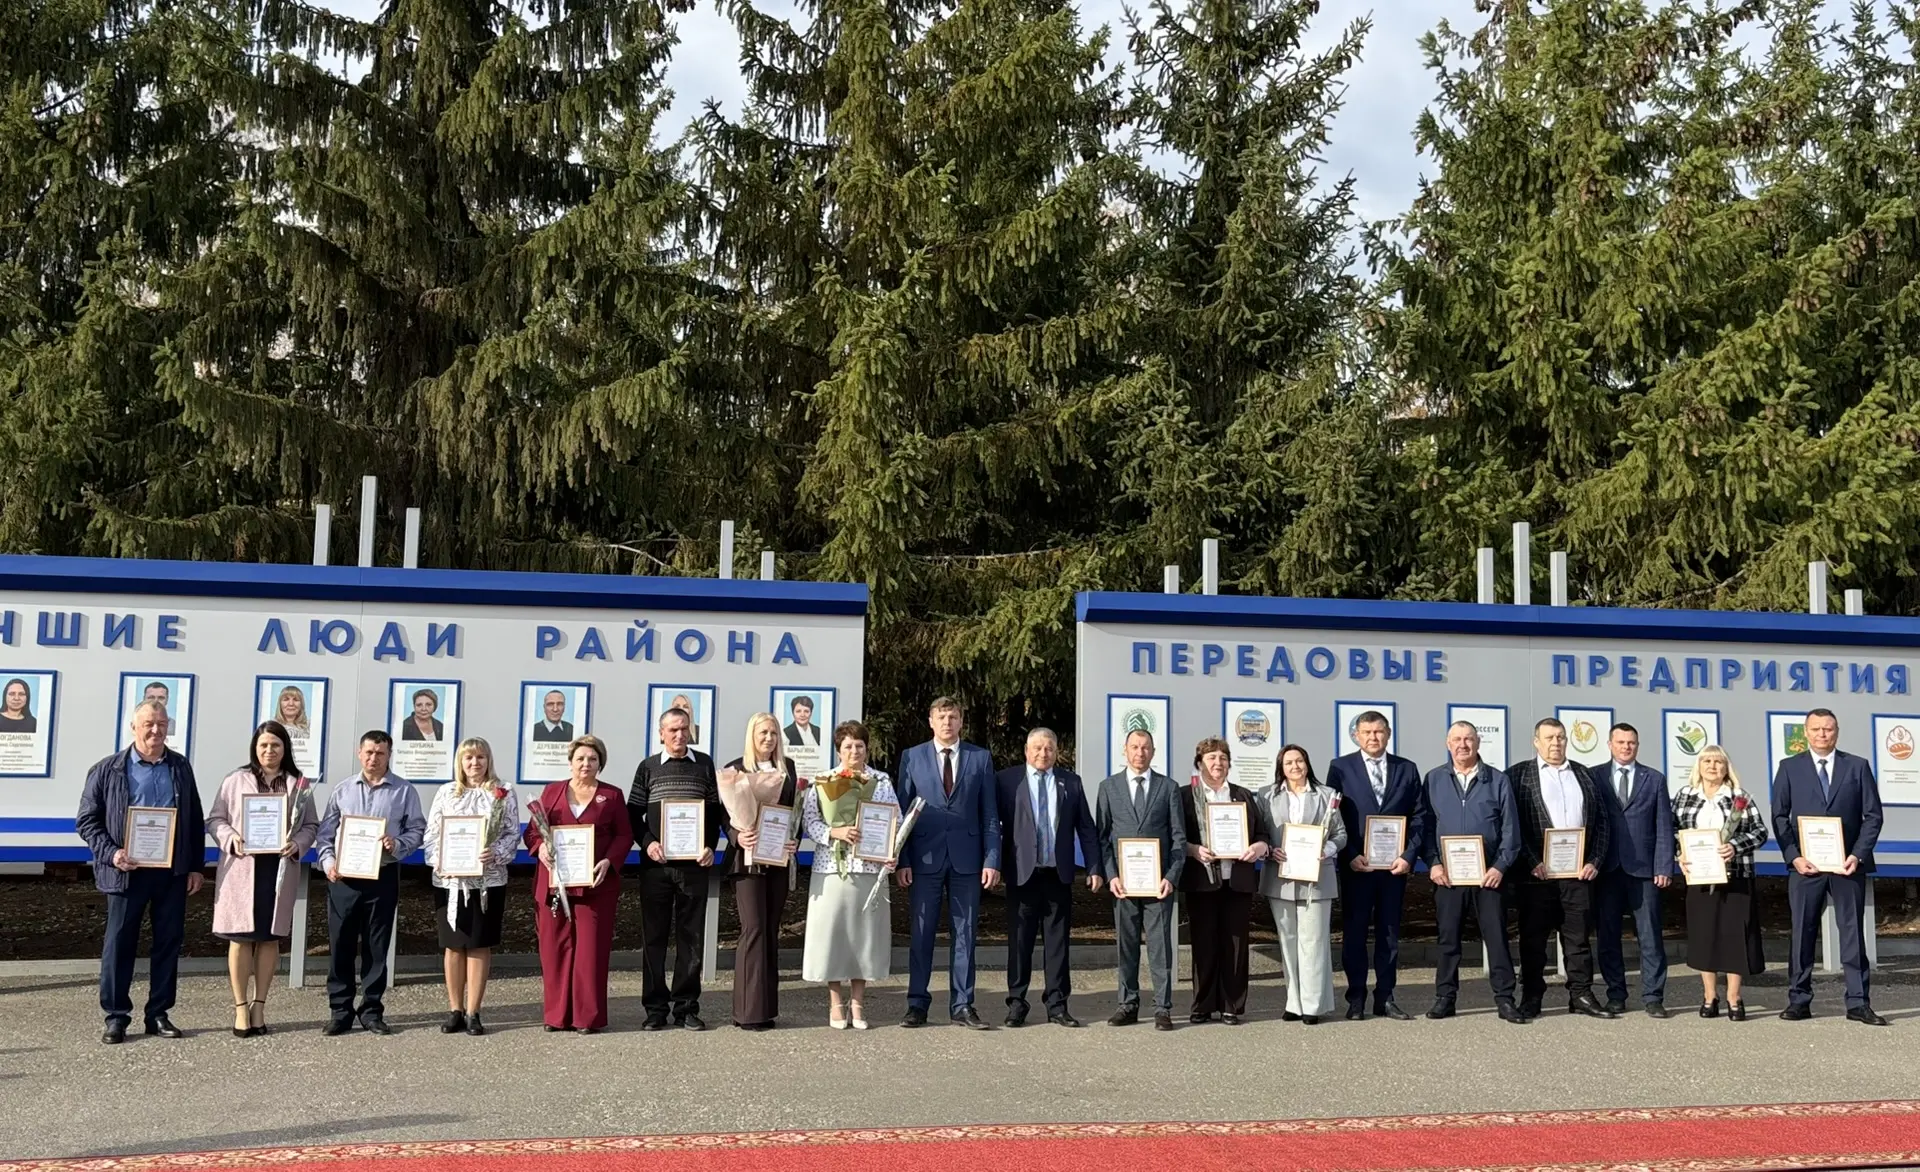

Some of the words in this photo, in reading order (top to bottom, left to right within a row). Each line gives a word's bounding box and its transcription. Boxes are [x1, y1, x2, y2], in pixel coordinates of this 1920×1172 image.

[257, 618, 457, 661] ЛЮДИ
[536, 619, 802, 664] РАЙОНА
[1132, 641, 1443, 683] ПЕРЕДОВЫЕ
[1552, 654, 1907, 694] ПРЕДПРИЯТИЯ
[1475, 725, 1499, 733] ОССЕТИ
